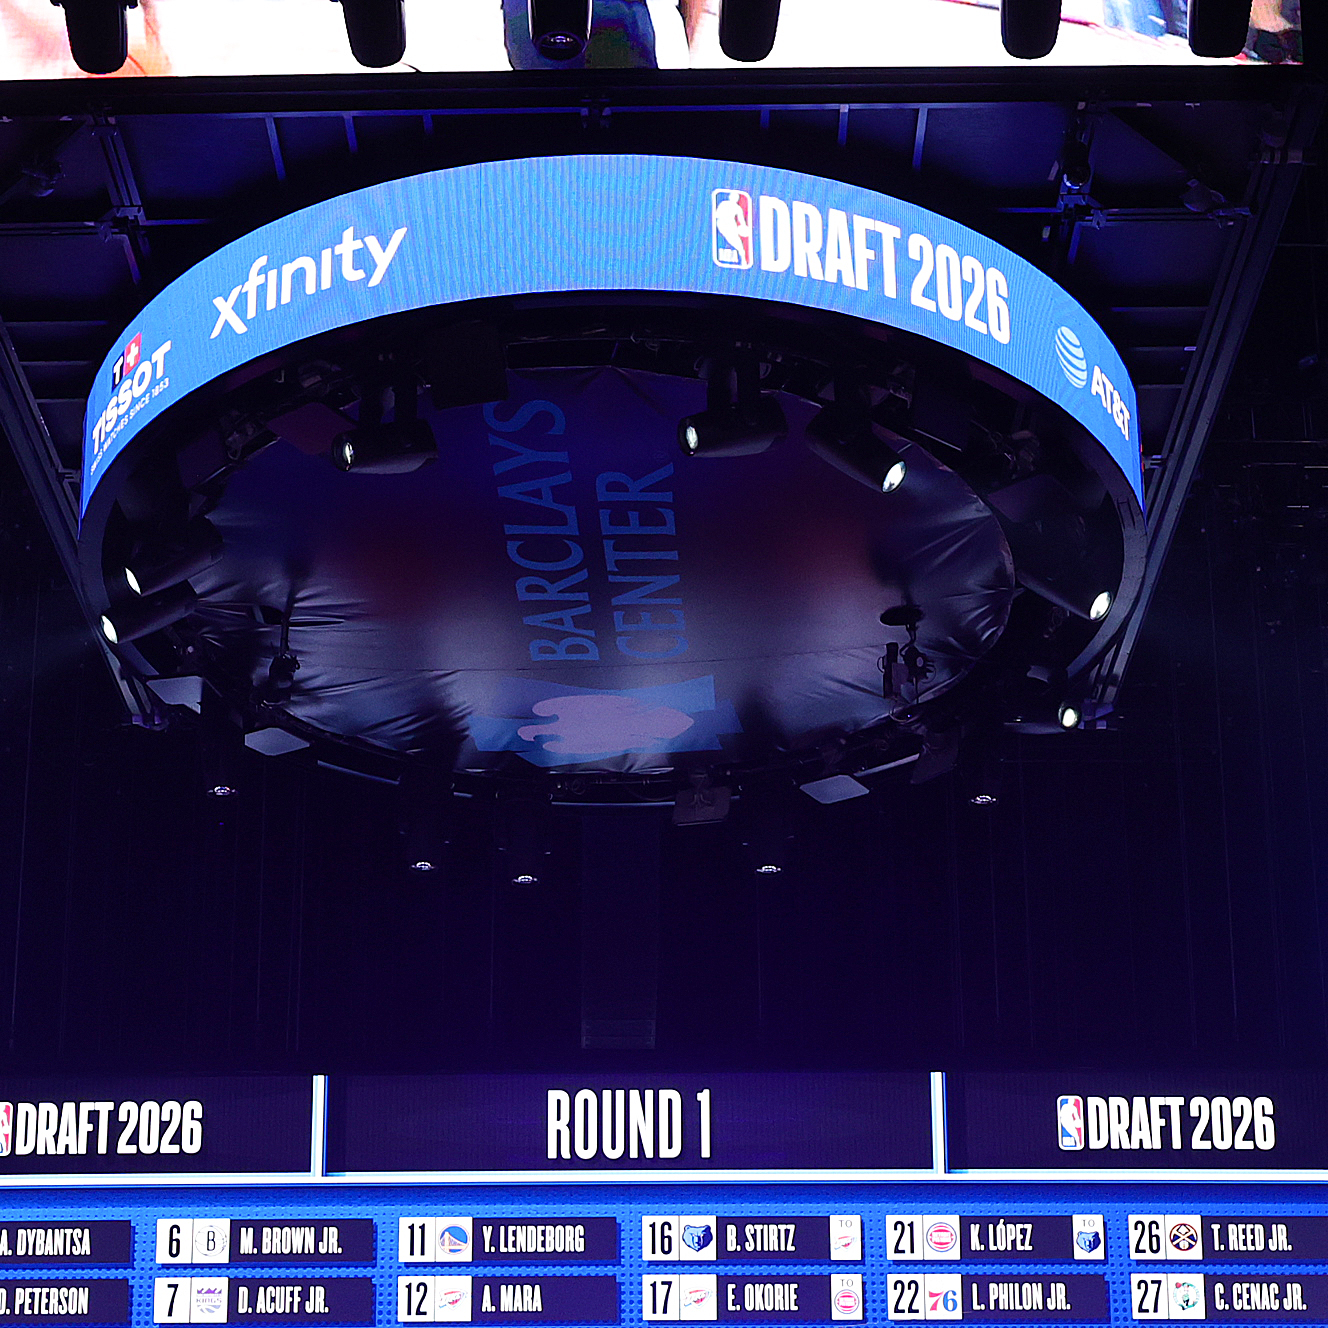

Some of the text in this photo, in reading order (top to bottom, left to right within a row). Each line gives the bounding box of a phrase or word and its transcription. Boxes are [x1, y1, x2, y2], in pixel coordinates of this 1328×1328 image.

[210, 226, 408, 339] xfinity
[759, 195, 1011, 344] DRAFT 2026
[92, 339, 172, 455] TISSOT
[1091, 365, 1131, 441] AT&T
[482, 399, 600, 661] BARCLAYS
[595, 462, 689, 659] CENTER
[15, 1100, 204, 1155] DRAFT 2026
[547, 1088, 711, 1160] ROUND 1
[1087, 1096, 1276, 1150] DRAFT 2026
[169, 1224, 344, 1258] 6 M. BROWN JR.
[407, 1223, 586, 1257] 11 Y. LENDEBORG
[650, 1221, 797, 1255] 16 B. STIRTZ
[838, 1219, 853, 1228] TO
[894, 1218, 1034, 1255] 21 K. LÓPEZ
[1082, 1219, 1095, 1228] TO
[1135, 1220, 1294, 1255] 26 T. REED JR.
[0, 1229, 14, 1257] A.
[17, 1229, 92, 1257] DYBANTSA
[168, 1283, 330, 1317] 7 D. ACUFF JR.
[404, 1281, 544, 1317] 12 A. MARA
[650, 1280, 674, 1315] 17
[728, 1284, 742, 1312] E.
[745, 1284, 800, 1313] OKORIE
[840, 1278, 854, 1288] TO
[894, 1279, 1072, 1314] 22 L. PHILON JR.
[1137, 1279, 1308, 1313] 27 C. CENAC JR.
[15, 1287, 90, 1316] PETERSON
[928, 1289, 959, 1313] 76
